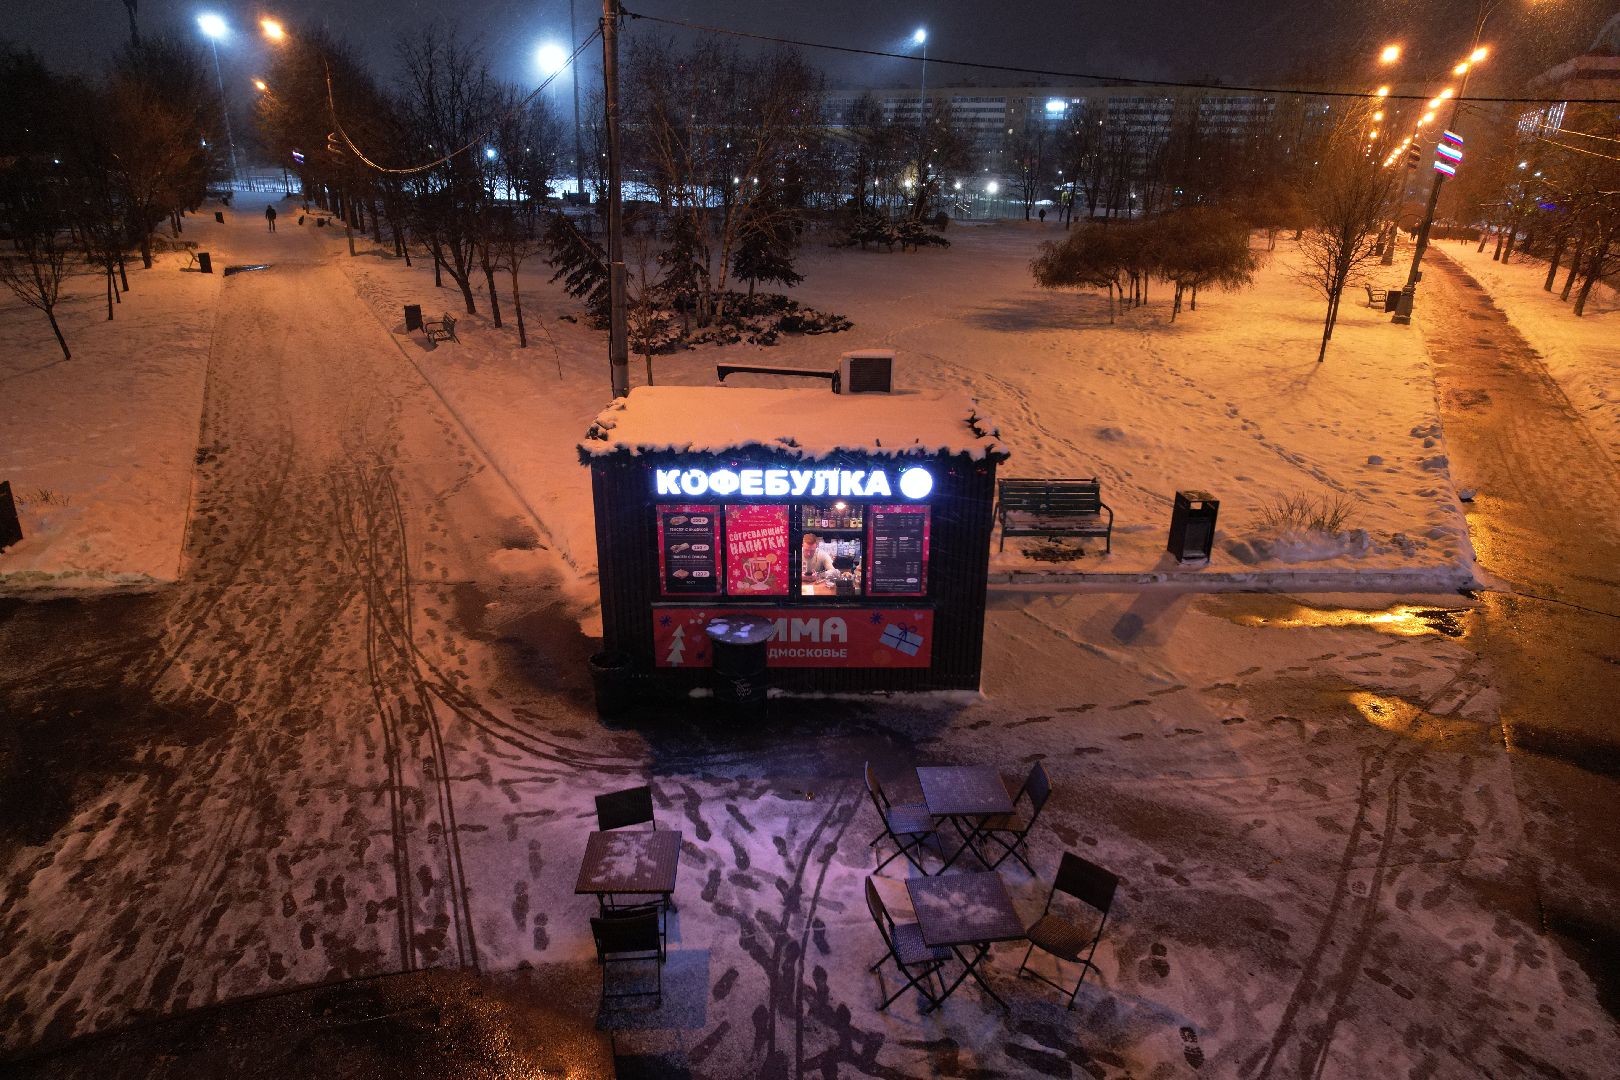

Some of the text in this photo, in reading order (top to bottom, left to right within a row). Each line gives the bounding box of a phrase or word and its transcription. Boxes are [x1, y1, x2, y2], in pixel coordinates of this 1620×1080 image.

[656, 468, 892, 496] КОФЕБУЛКА
[729, 525, 785, 542] СОГРЕВАЮЩИЕ
[729, 535, 785, 556] НАПИТКИ
[767, 617, 848, 642] ИМА
[767, 648, 848, 659] ДМОСКОВЬЕ
